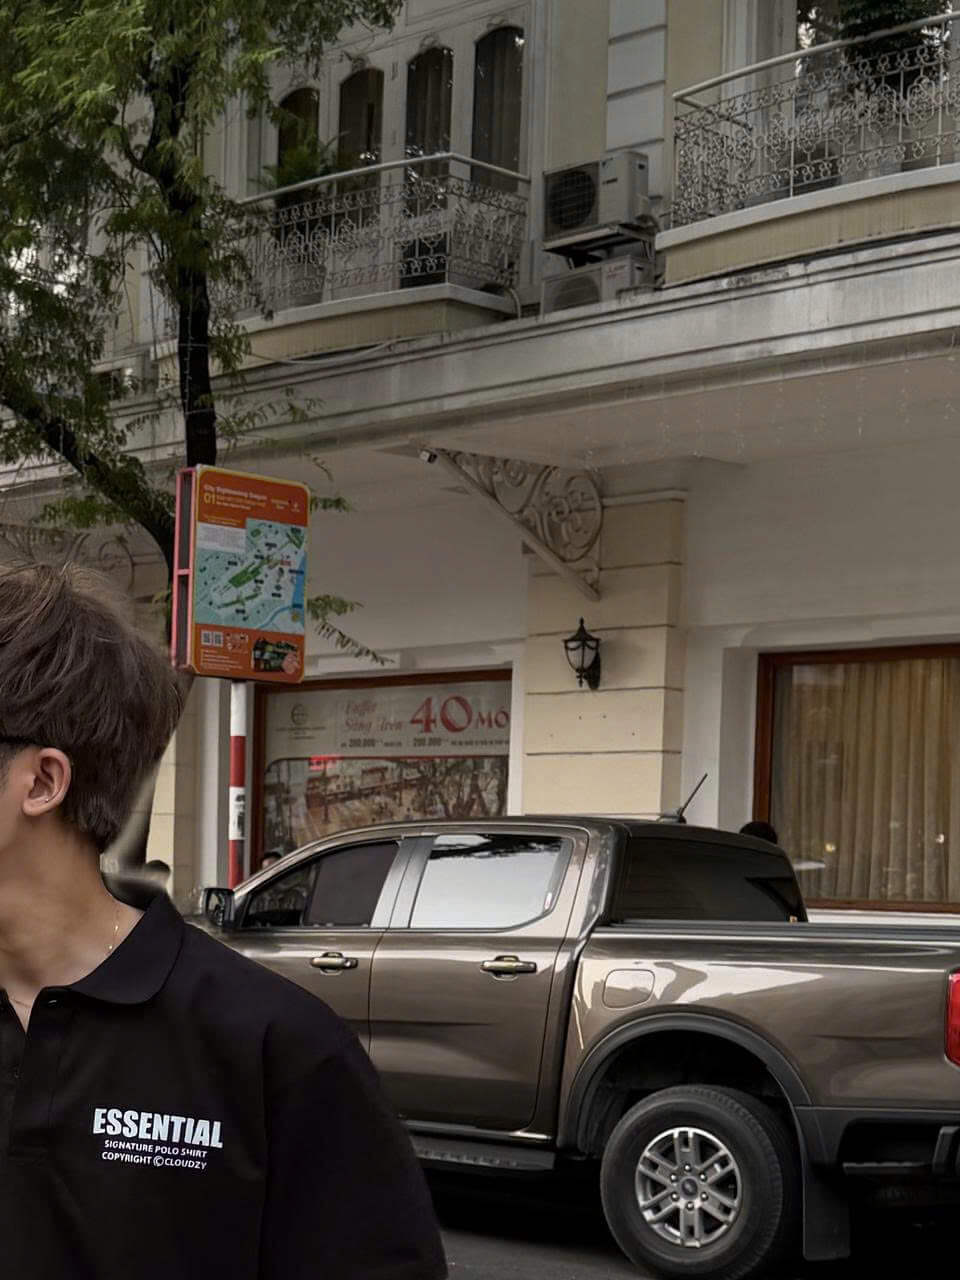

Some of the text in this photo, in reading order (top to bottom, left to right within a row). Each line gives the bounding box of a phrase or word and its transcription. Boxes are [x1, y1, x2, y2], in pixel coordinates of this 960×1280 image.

[410, 695, 473, 733] 40
[92, 1107, 224, 1149] ESSENTIAL
[101, 1151, 152, 1166] COPYRIGHT
[104, 1139, 208, 1159] SIGNATURE POLO SHIRT
